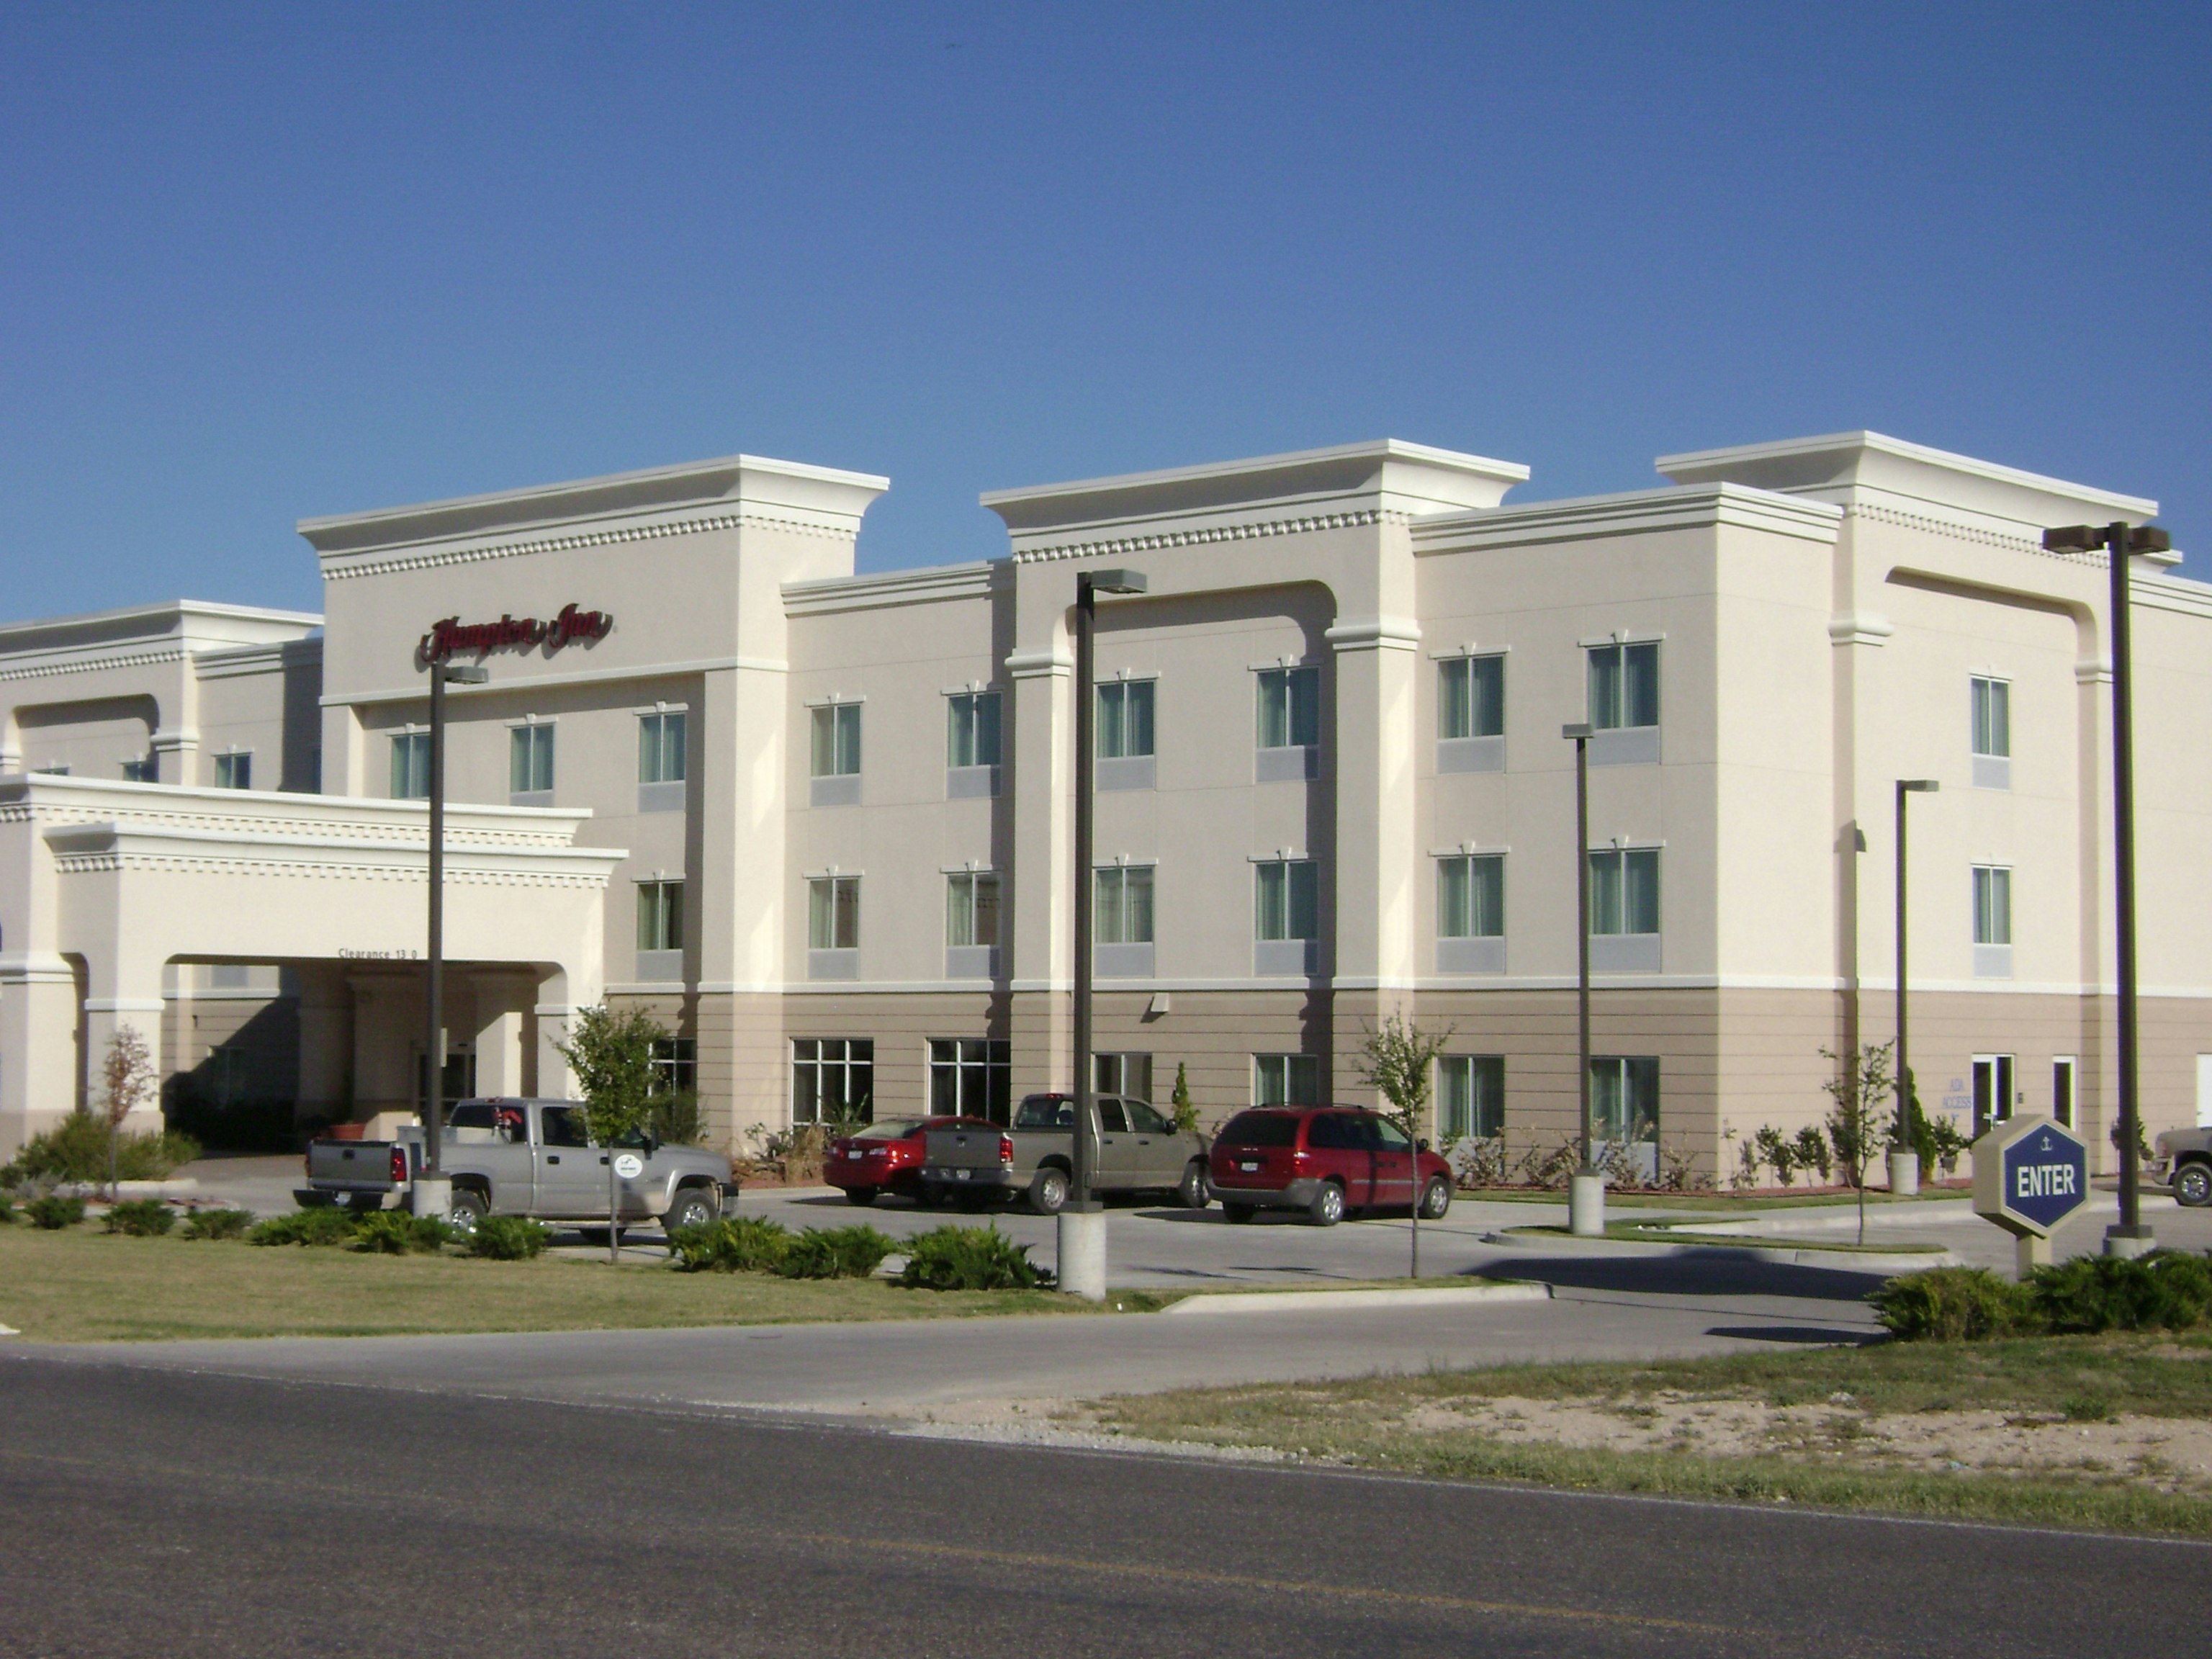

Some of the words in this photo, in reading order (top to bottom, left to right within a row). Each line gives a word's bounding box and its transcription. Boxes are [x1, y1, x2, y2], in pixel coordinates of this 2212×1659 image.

[420, 614, 547, 662] Hampton
[547, 603, 613, 649] Inn
[338, 948, 390, 959] Clearance
[2018, 1164, 2076, 1197] ENTER
